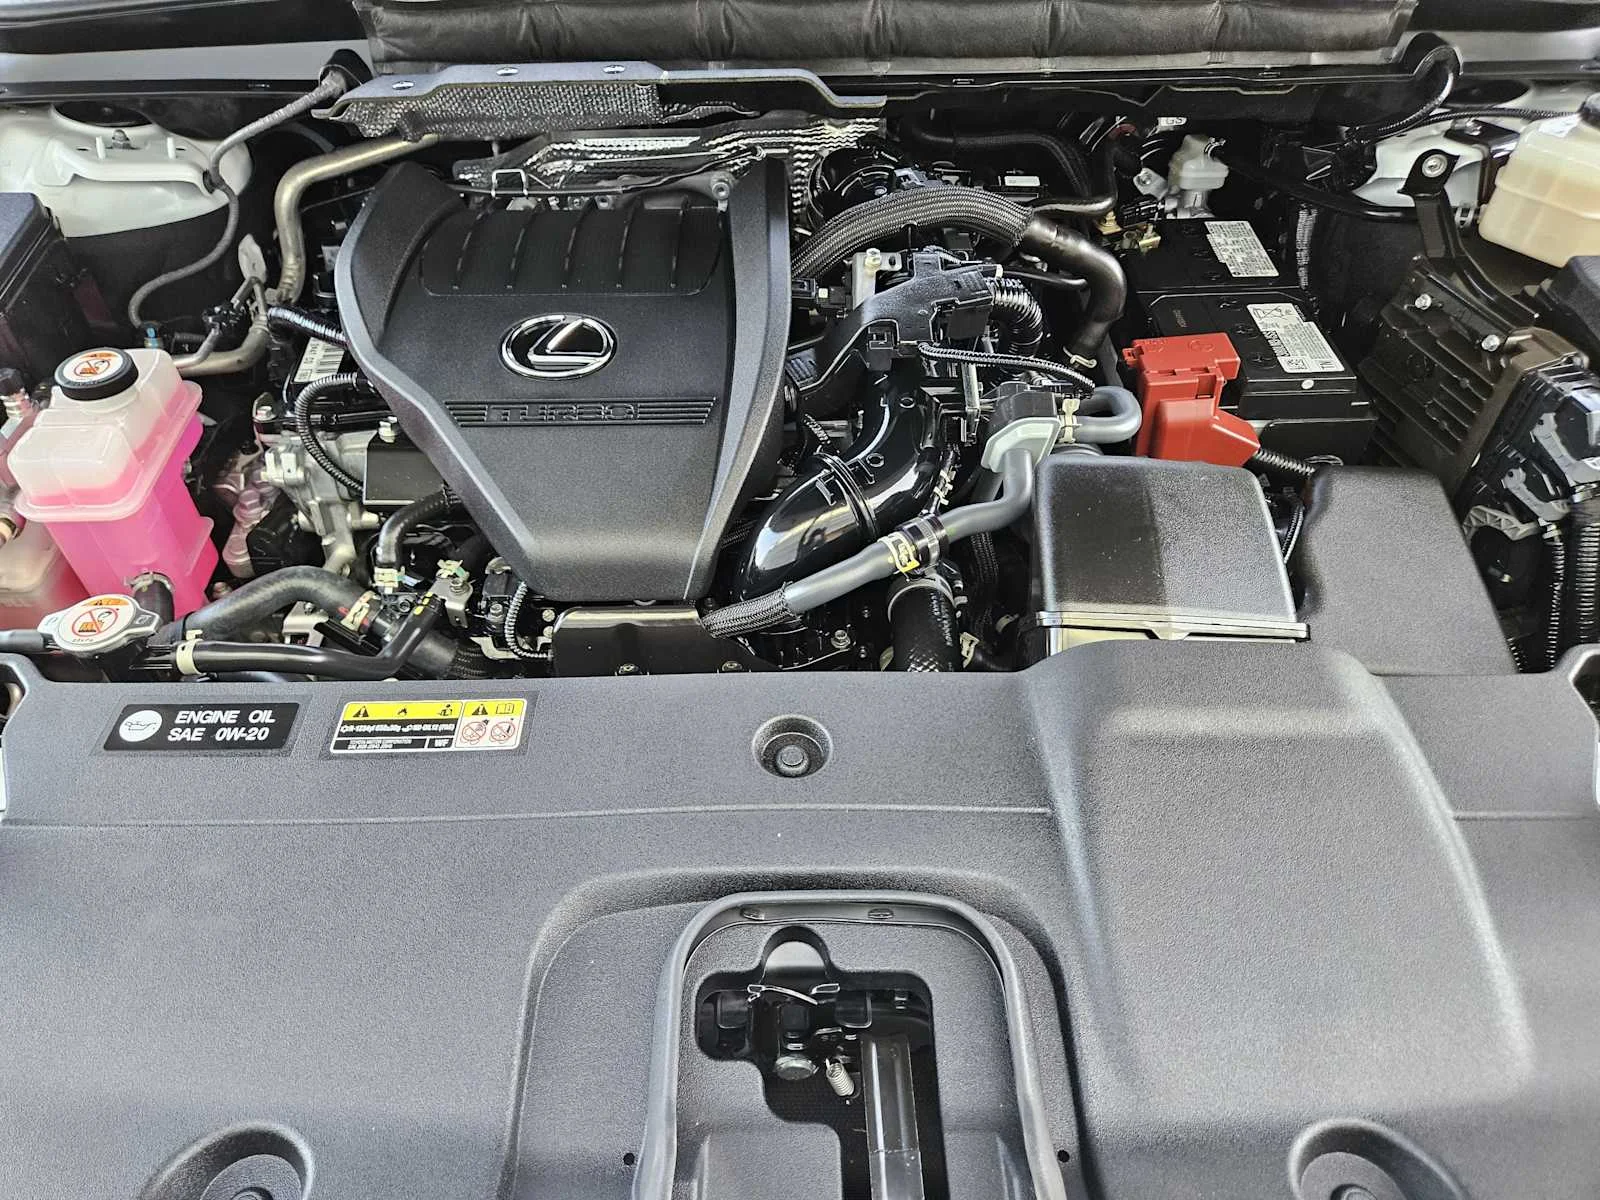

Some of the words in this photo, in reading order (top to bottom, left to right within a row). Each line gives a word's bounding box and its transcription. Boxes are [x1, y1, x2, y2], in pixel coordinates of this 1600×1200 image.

[488, 402, 637, 422] TURBO
[174, 710, 241, 724] ENGINE
[248, 709, 277, 724] OIL
[167, 727, 207, 742] SAE
[215, 727, 270, 741] 0W-20
